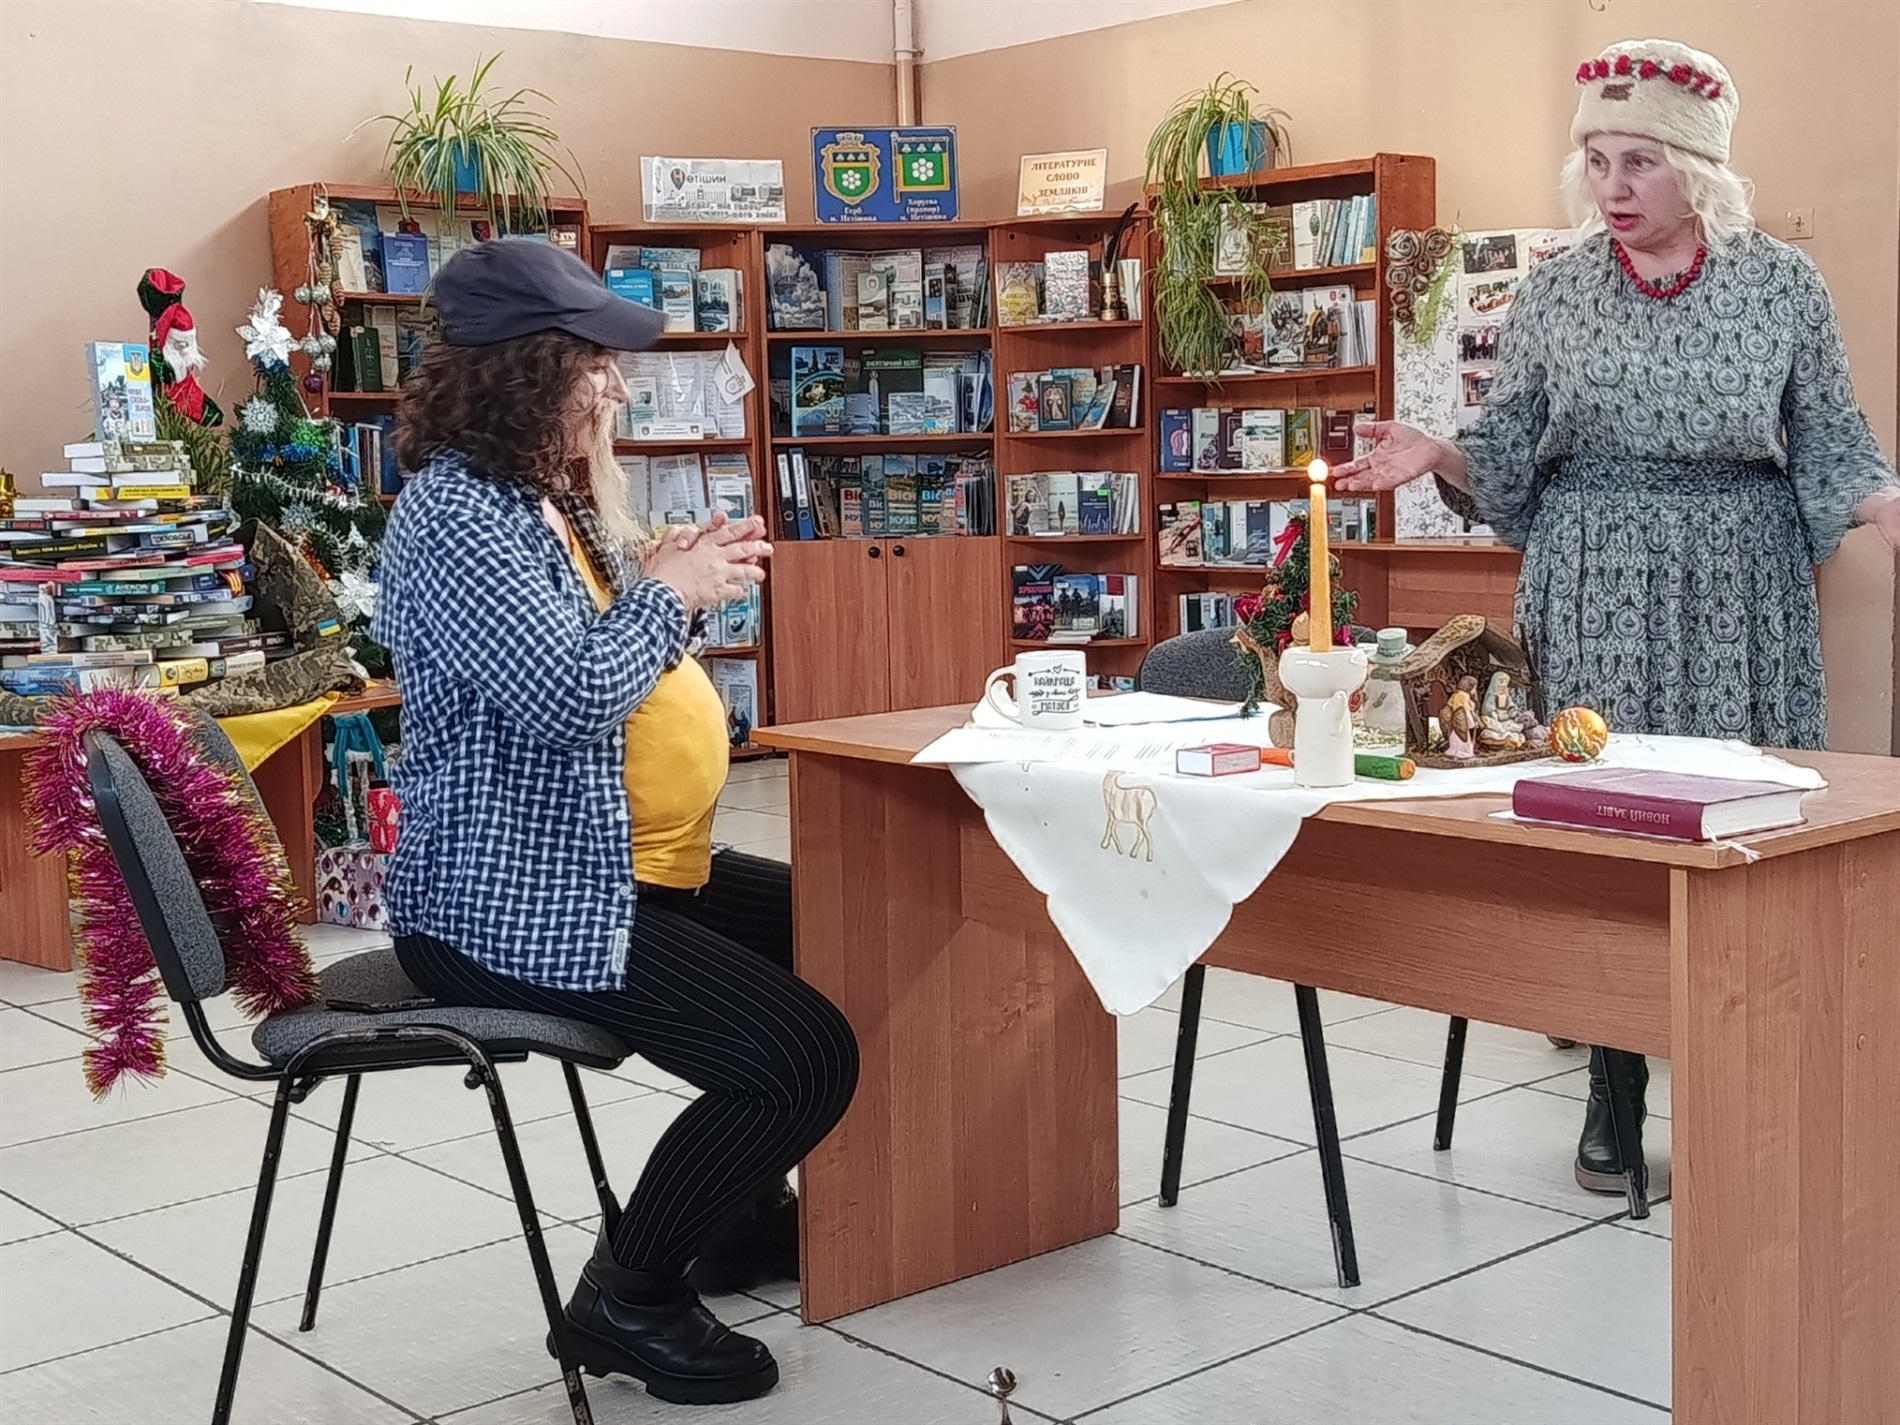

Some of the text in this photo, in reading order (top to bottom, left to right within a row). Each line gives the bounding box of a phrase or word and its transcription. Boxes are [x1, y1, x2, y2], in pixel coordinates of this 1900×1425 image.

[1031, 158, 1097, 171] ЛІТЕРАТУРНЕ
[1046, 172, 1080, 182] СЛОВО
[1038, 186, 1088, 198] ЗЕМЛЯКІВ
[1034, 676, 1075, 686] НАЙКРАЩА
[1595, 805, 1671, 825] НОВИЙ ЗАВІТ
